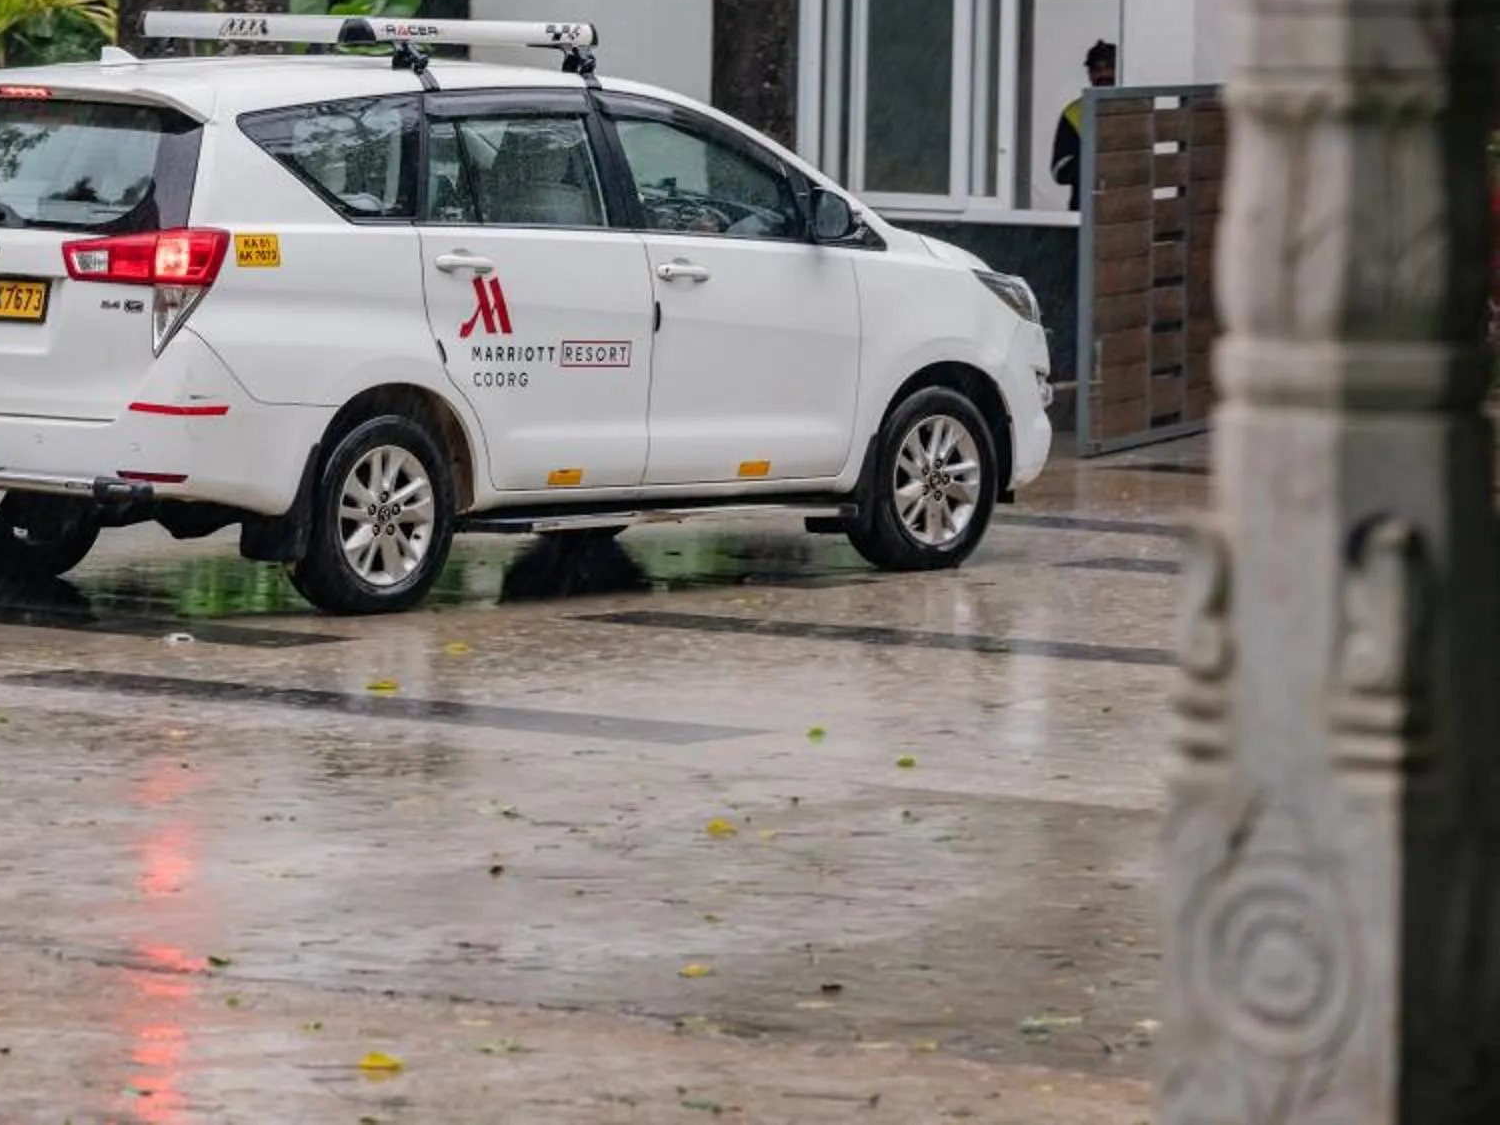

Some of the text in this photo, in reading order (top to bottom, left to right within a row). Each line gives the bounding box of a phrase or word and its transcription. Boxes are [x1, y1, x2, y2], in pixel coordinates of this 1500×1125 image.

[386, 24, 438, 36] RACER
[471, 345, 628, 363] MARRIOTT RESORT
[473, 371, 530, 388] COORG
